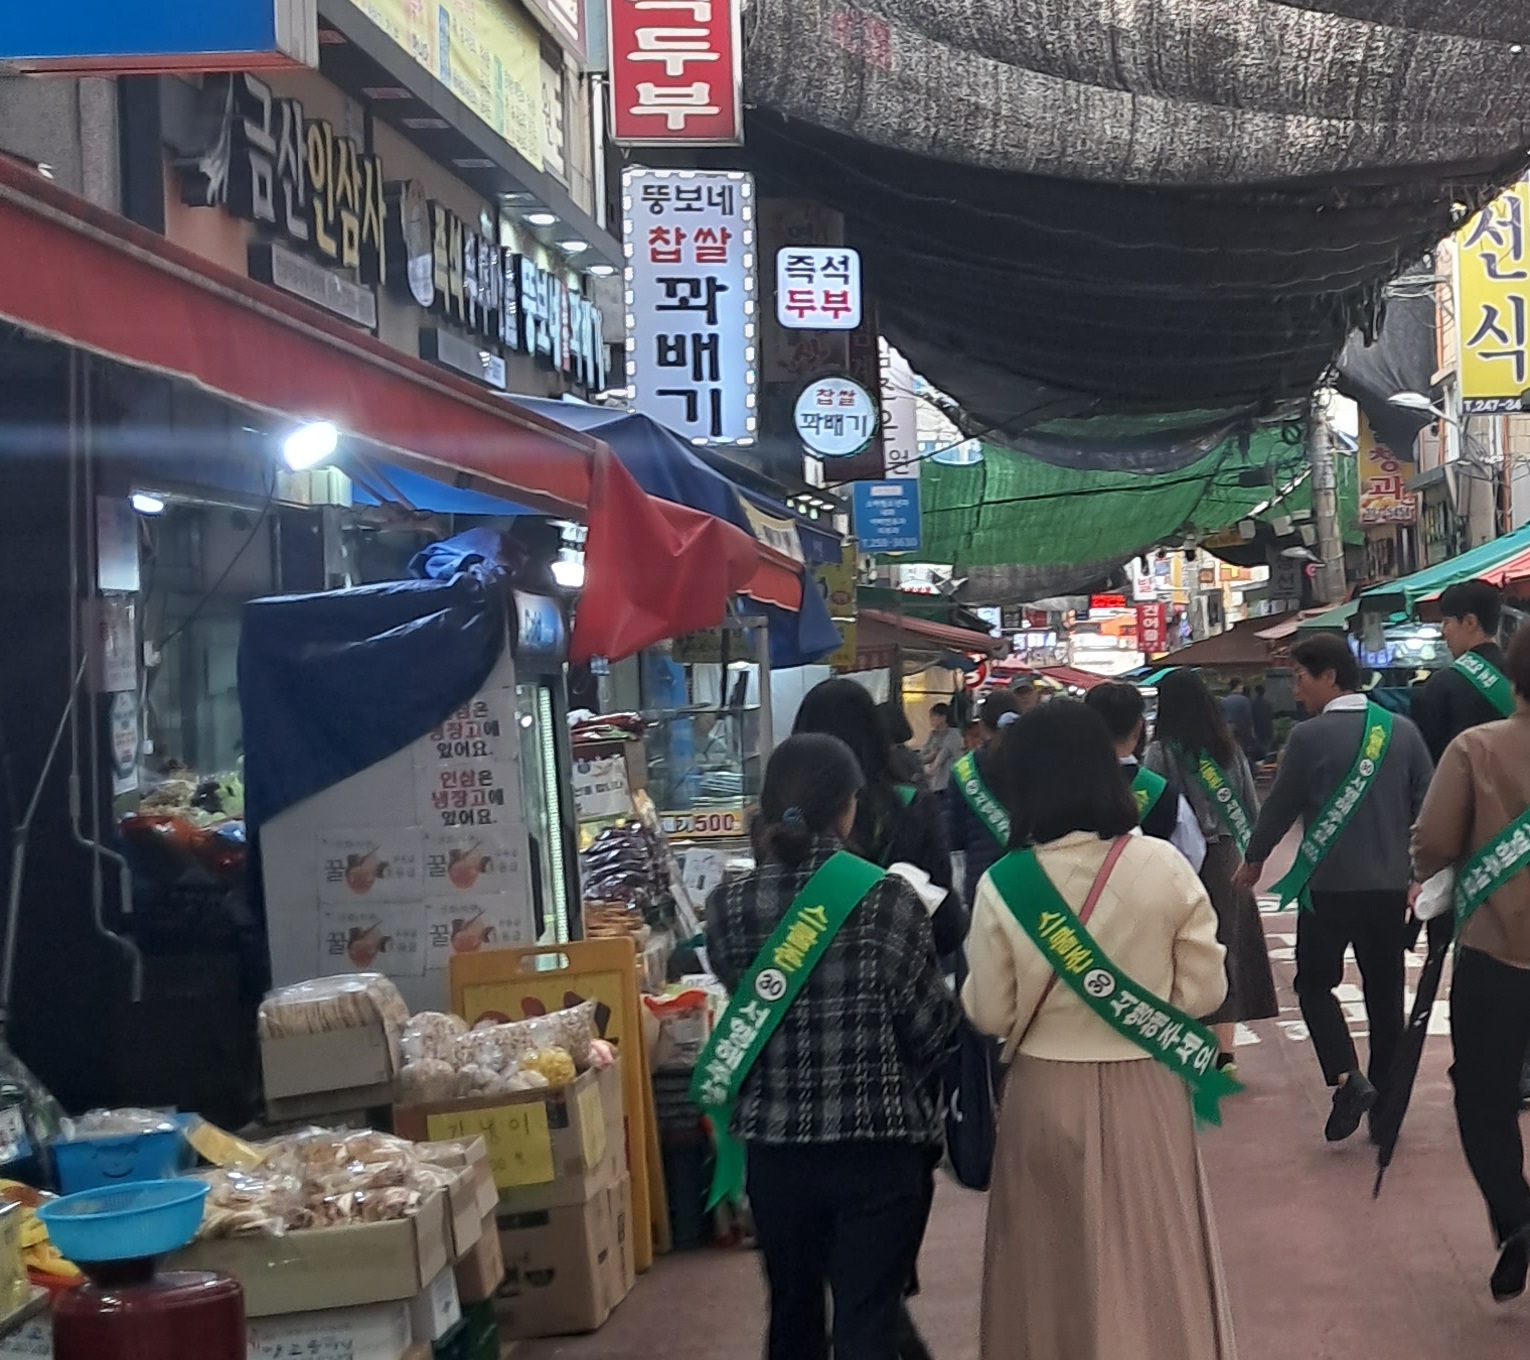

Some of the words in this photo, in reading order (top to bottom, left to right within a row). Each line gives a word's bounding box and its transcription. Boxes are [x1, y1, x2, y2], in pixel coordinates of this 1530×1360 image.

[641, 184, 734, 216] 뚱보네
[648, 226, 733, 264] 찹쌀
[784, 253, 851, 286] 즉석
[1463, 196, 1526, 383] 선식
[784, 289, 852, 321] 두부
[655, 275, 730, 437] 꽈배기
[815, 388, 858, 407] 찹쌀
[799, 412, 869, 439] 꽈배기
[440, 769, 494, 789] 인삼은
[432, 789, 504, 810] 냉장고에
[441, 809, 497, 827] 있어요.
[427, 854, 446, 879] 꿀
